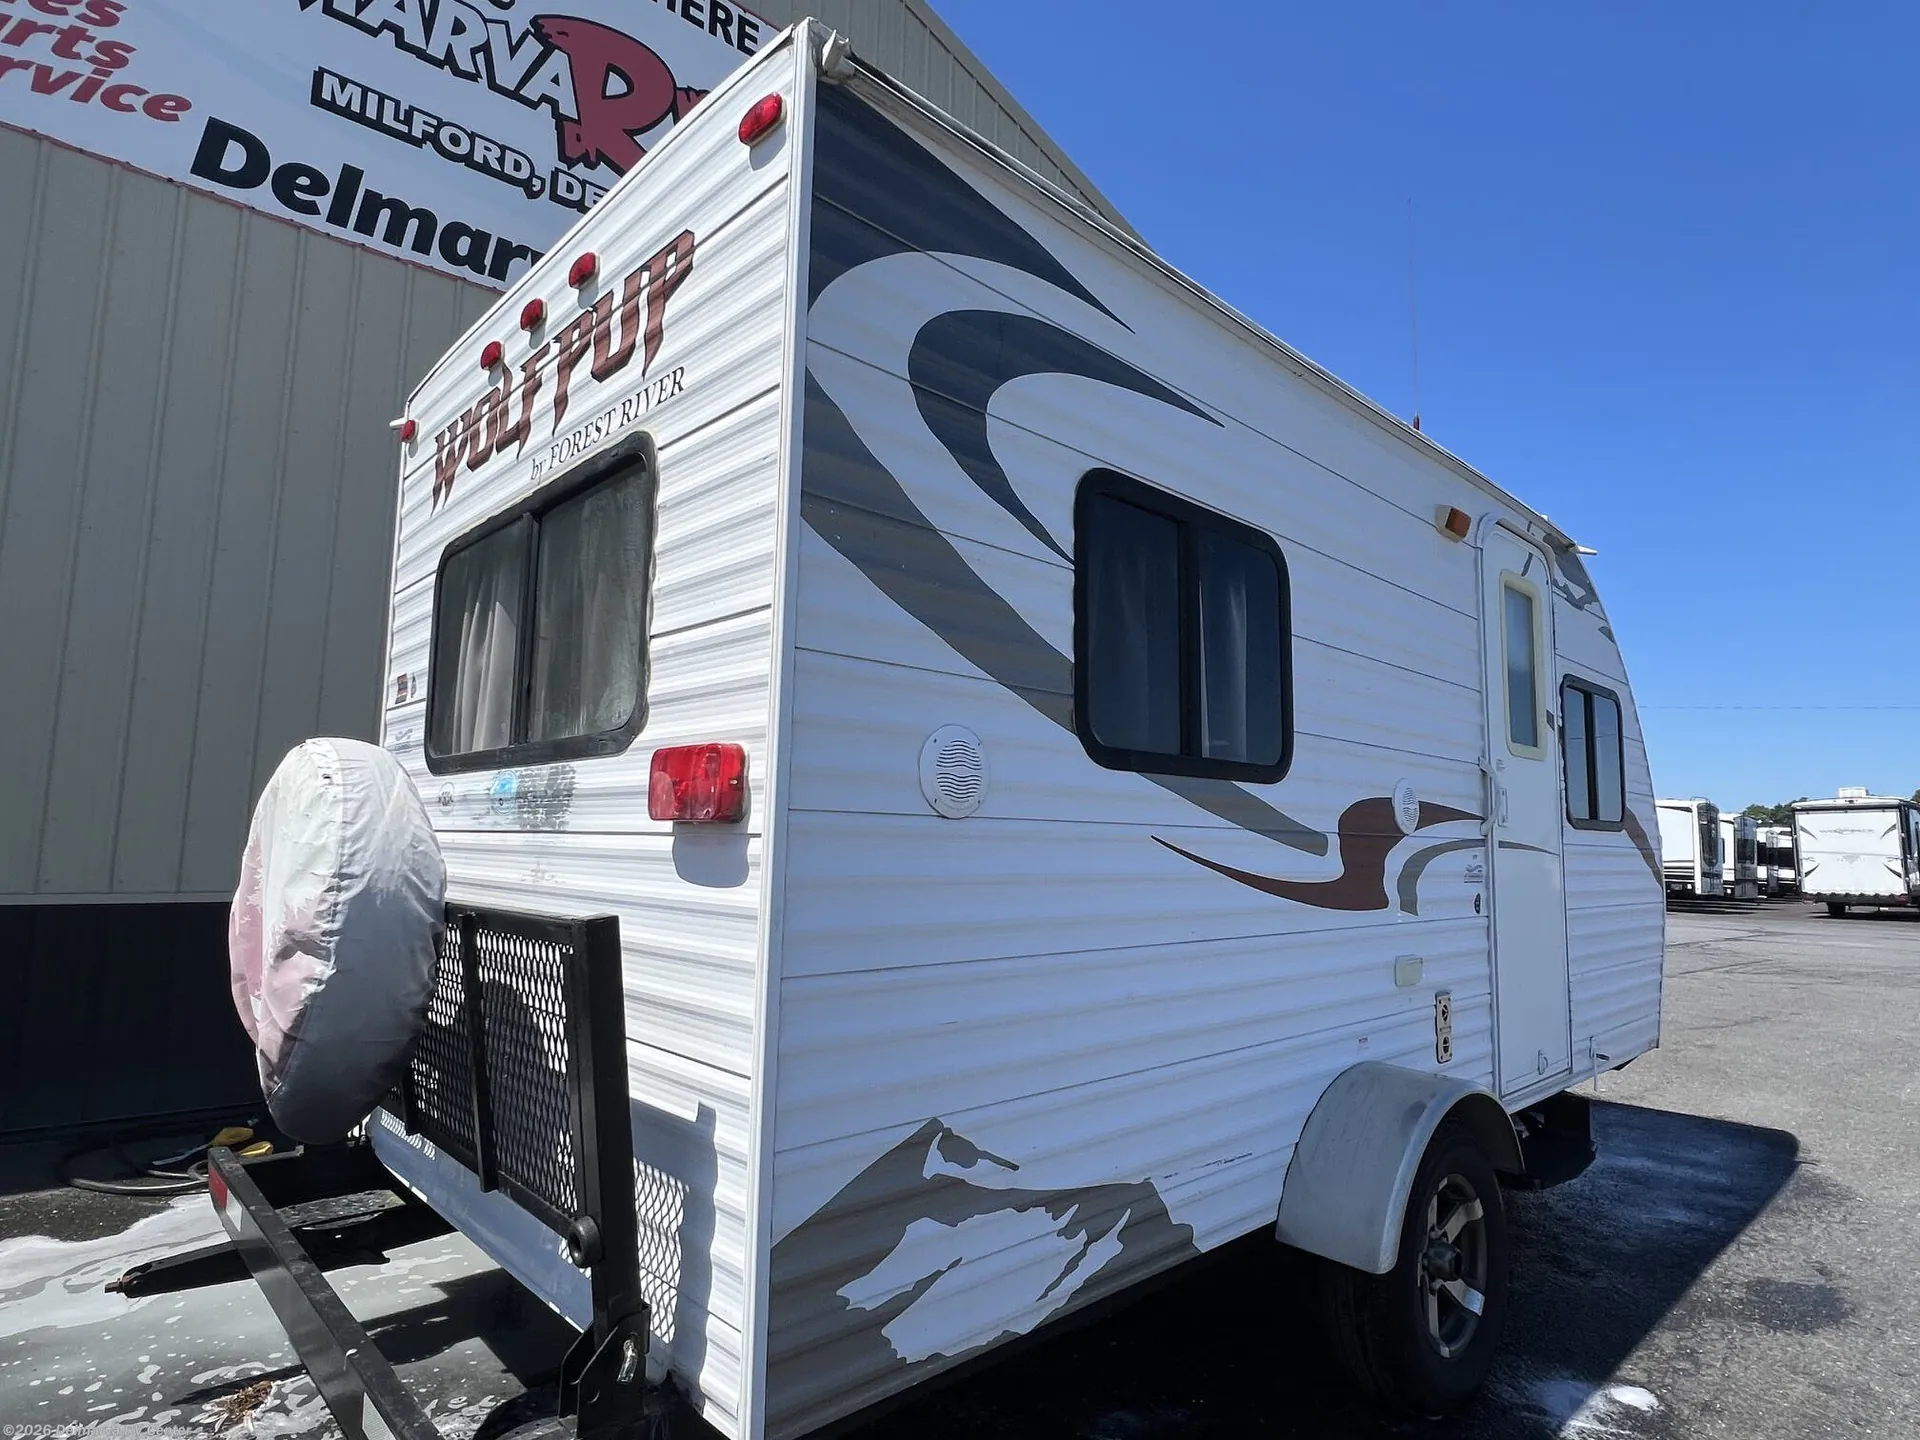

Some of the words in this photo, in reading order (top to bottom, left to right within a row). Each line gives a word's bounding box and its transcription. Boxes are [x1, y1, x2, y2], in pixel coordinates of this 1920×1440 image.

[0, 13, 137, 69] rts
[311, 66, 546, 200] MILFORD,
[530, 457, 547, 486] by
[549, 405, 617, 471] FOREST
[618, 366, 685, 429] RIVER
